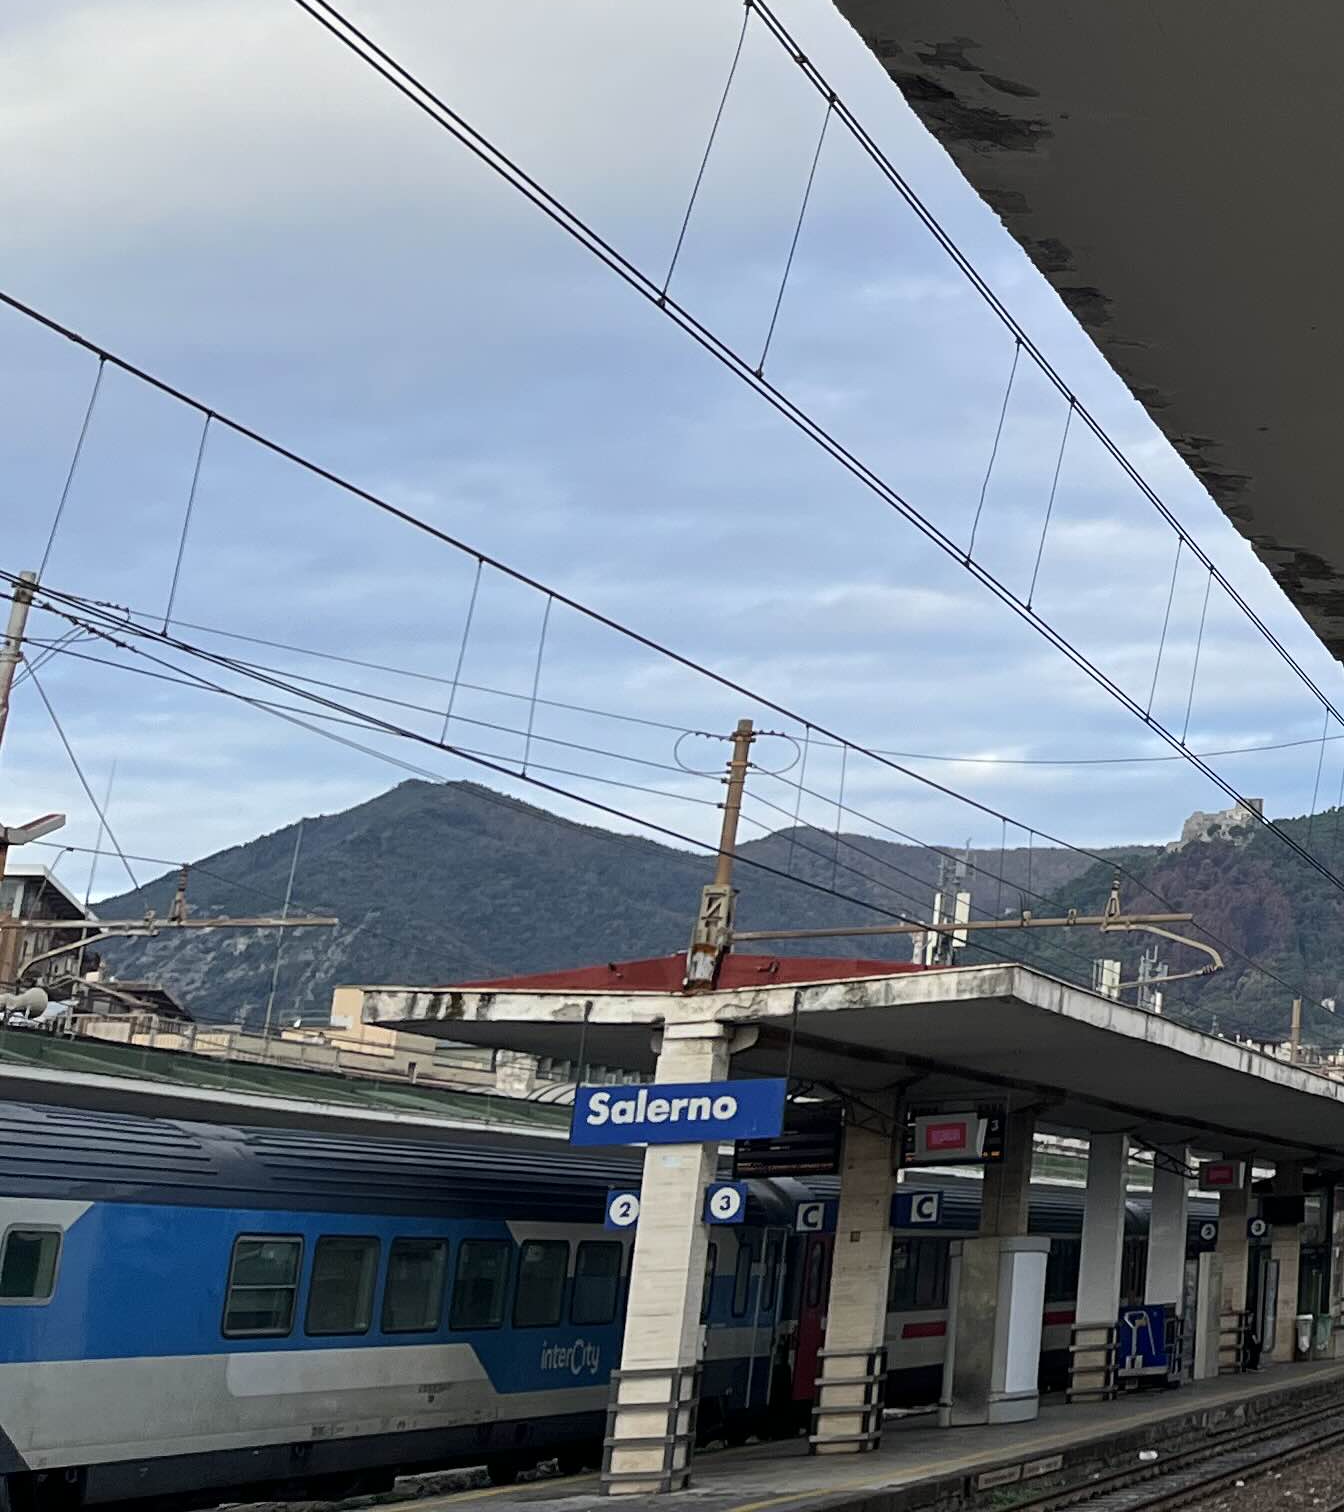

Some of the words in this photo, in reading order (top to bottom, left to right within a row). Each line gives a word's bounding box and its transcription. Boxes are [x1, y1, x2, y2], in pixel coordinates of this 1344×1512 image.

[585, 1088, 738, 1126] Salerno
[619, 1202, 632, 1218] 2
[719, 1194, 731, 1211] 3
[916, 1196, 934, 1219] C
[802, 1204, 819, 1228] C
